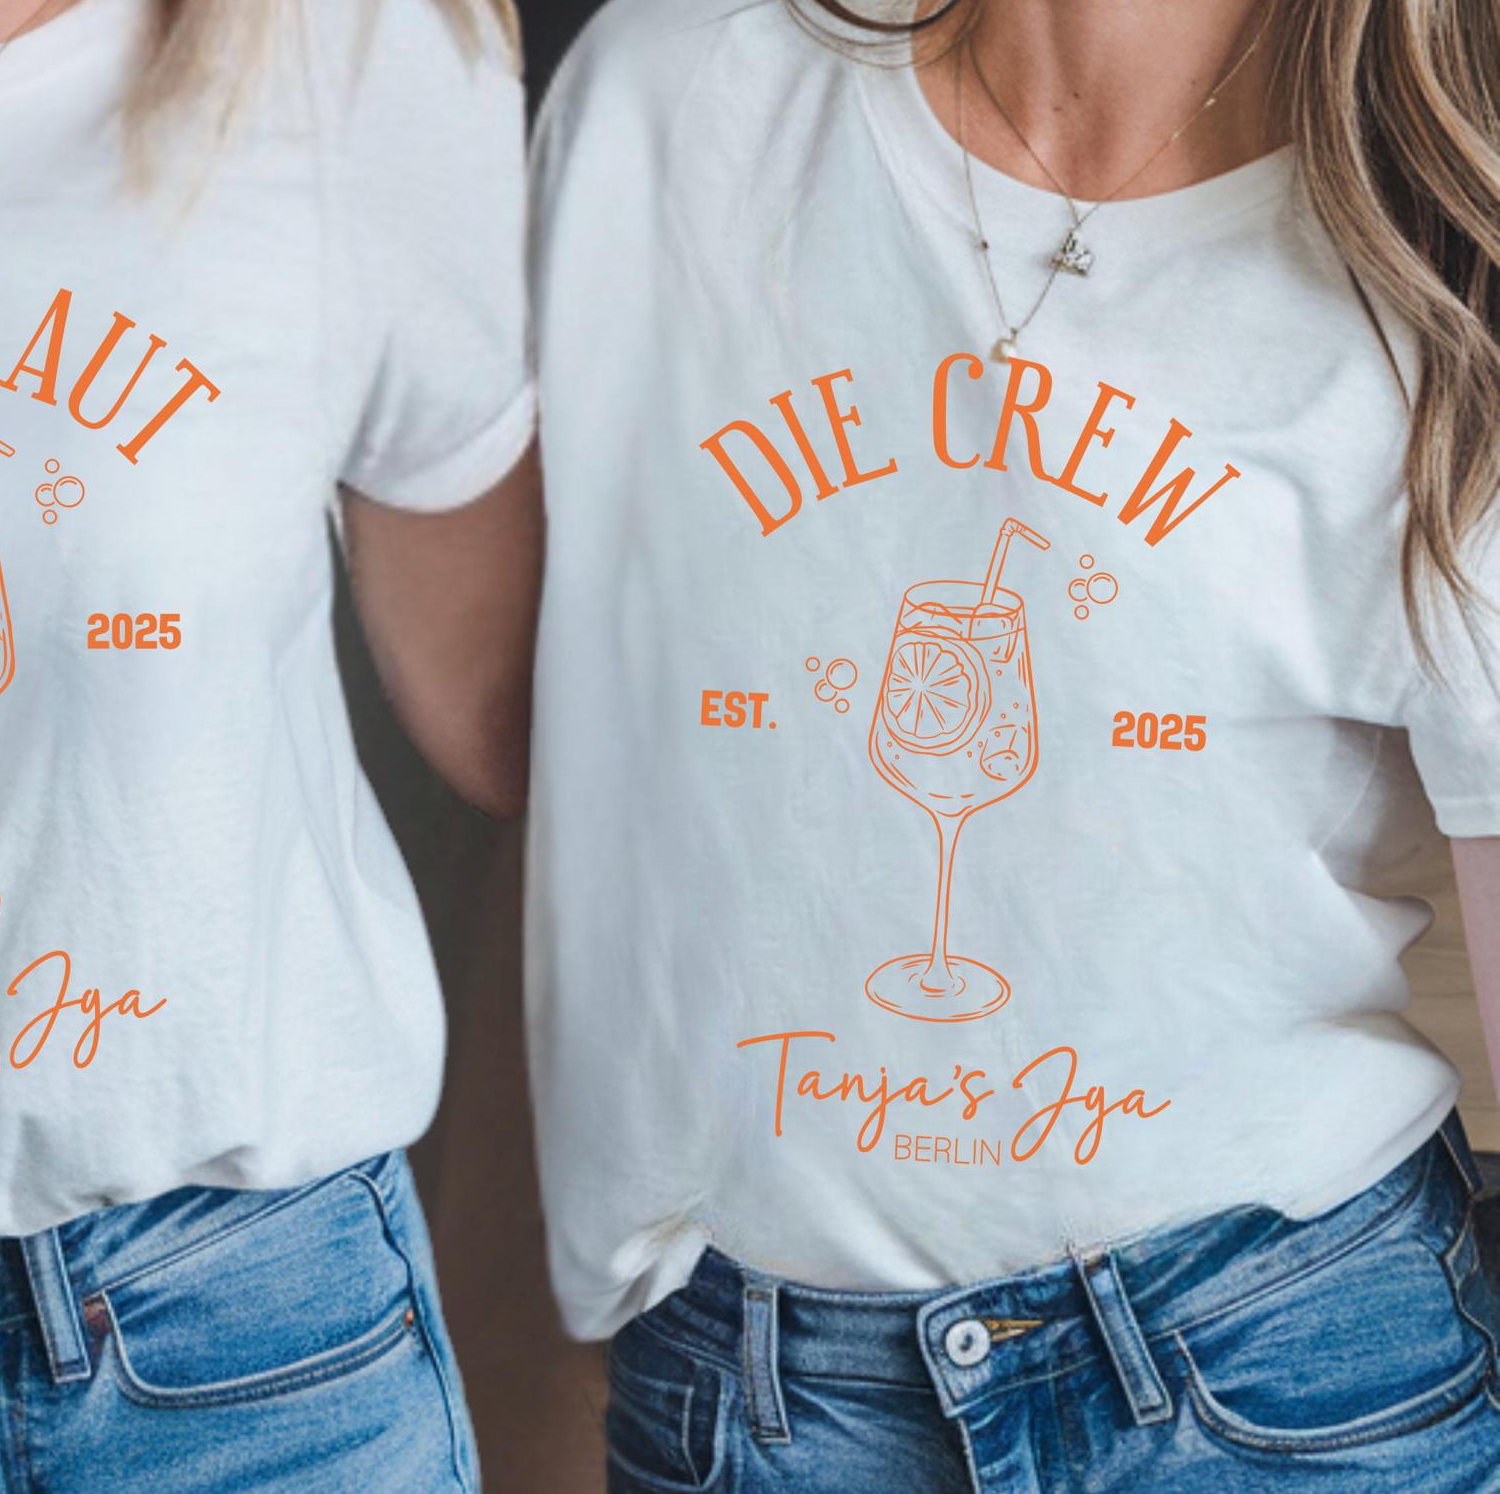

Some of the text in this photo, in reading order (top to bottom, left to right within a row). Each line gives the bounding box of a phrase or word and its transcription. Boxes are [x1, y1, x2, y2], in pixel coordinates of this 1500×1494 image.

[700, 352, 1241, 547] DIE CREW
[87, 613, 182, 650] 2025
[700, 690, 1207, 752] EST. 2025
[893, 1134, 1001, 1165] BERLIN
